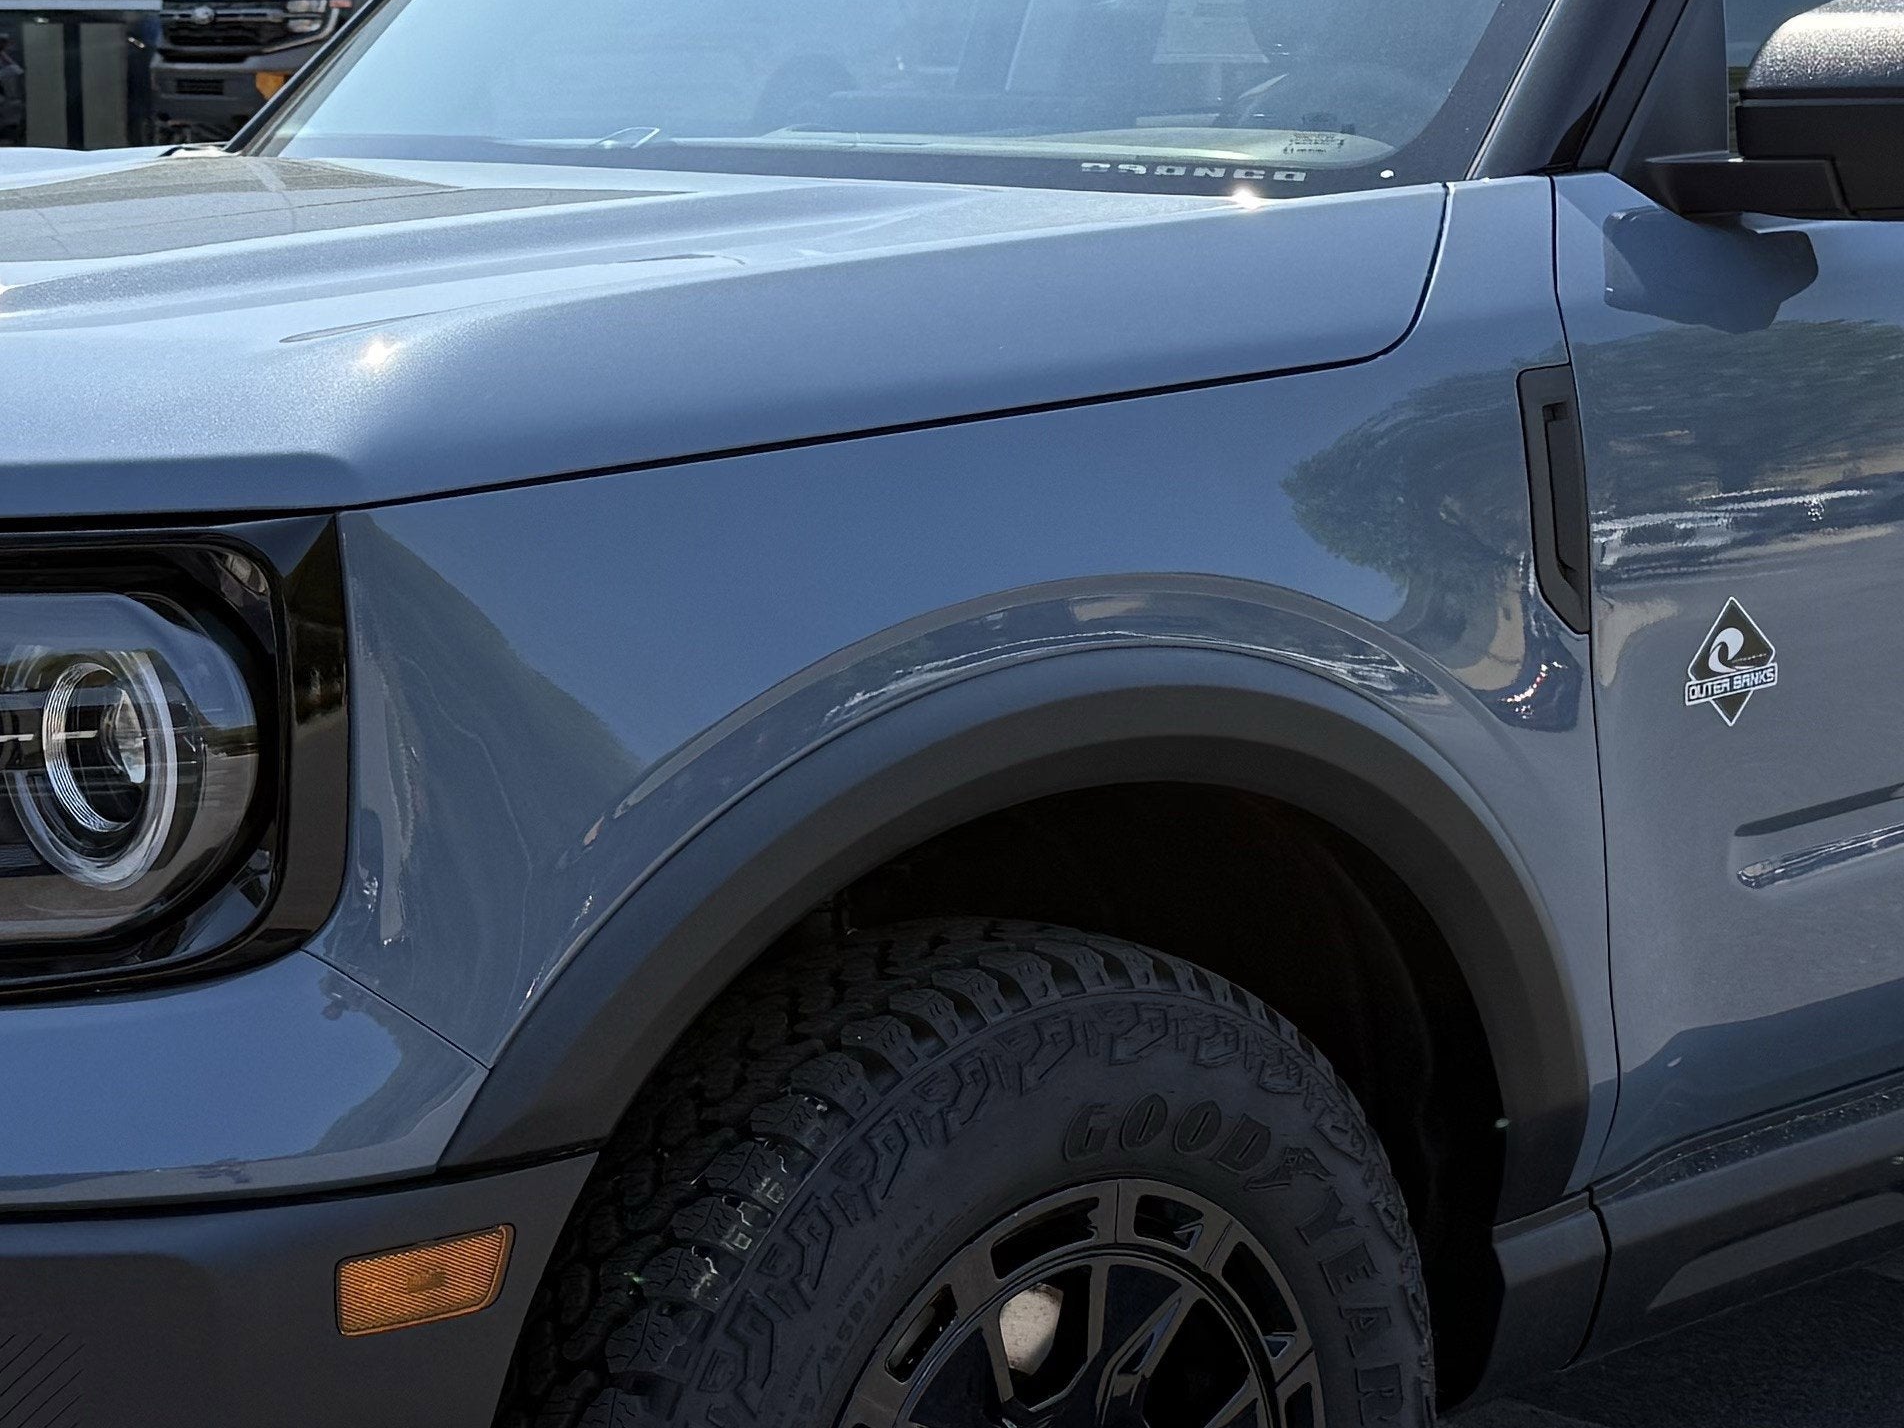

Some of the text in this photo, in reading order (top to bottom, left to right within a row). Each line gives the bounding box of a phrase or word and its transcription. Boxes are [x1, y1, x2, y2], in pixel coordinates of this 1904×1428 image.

[1689, 667, 1774, 700] OUTER BANKS
[1062, 1092, 1405, 1427] GOODYEAR
